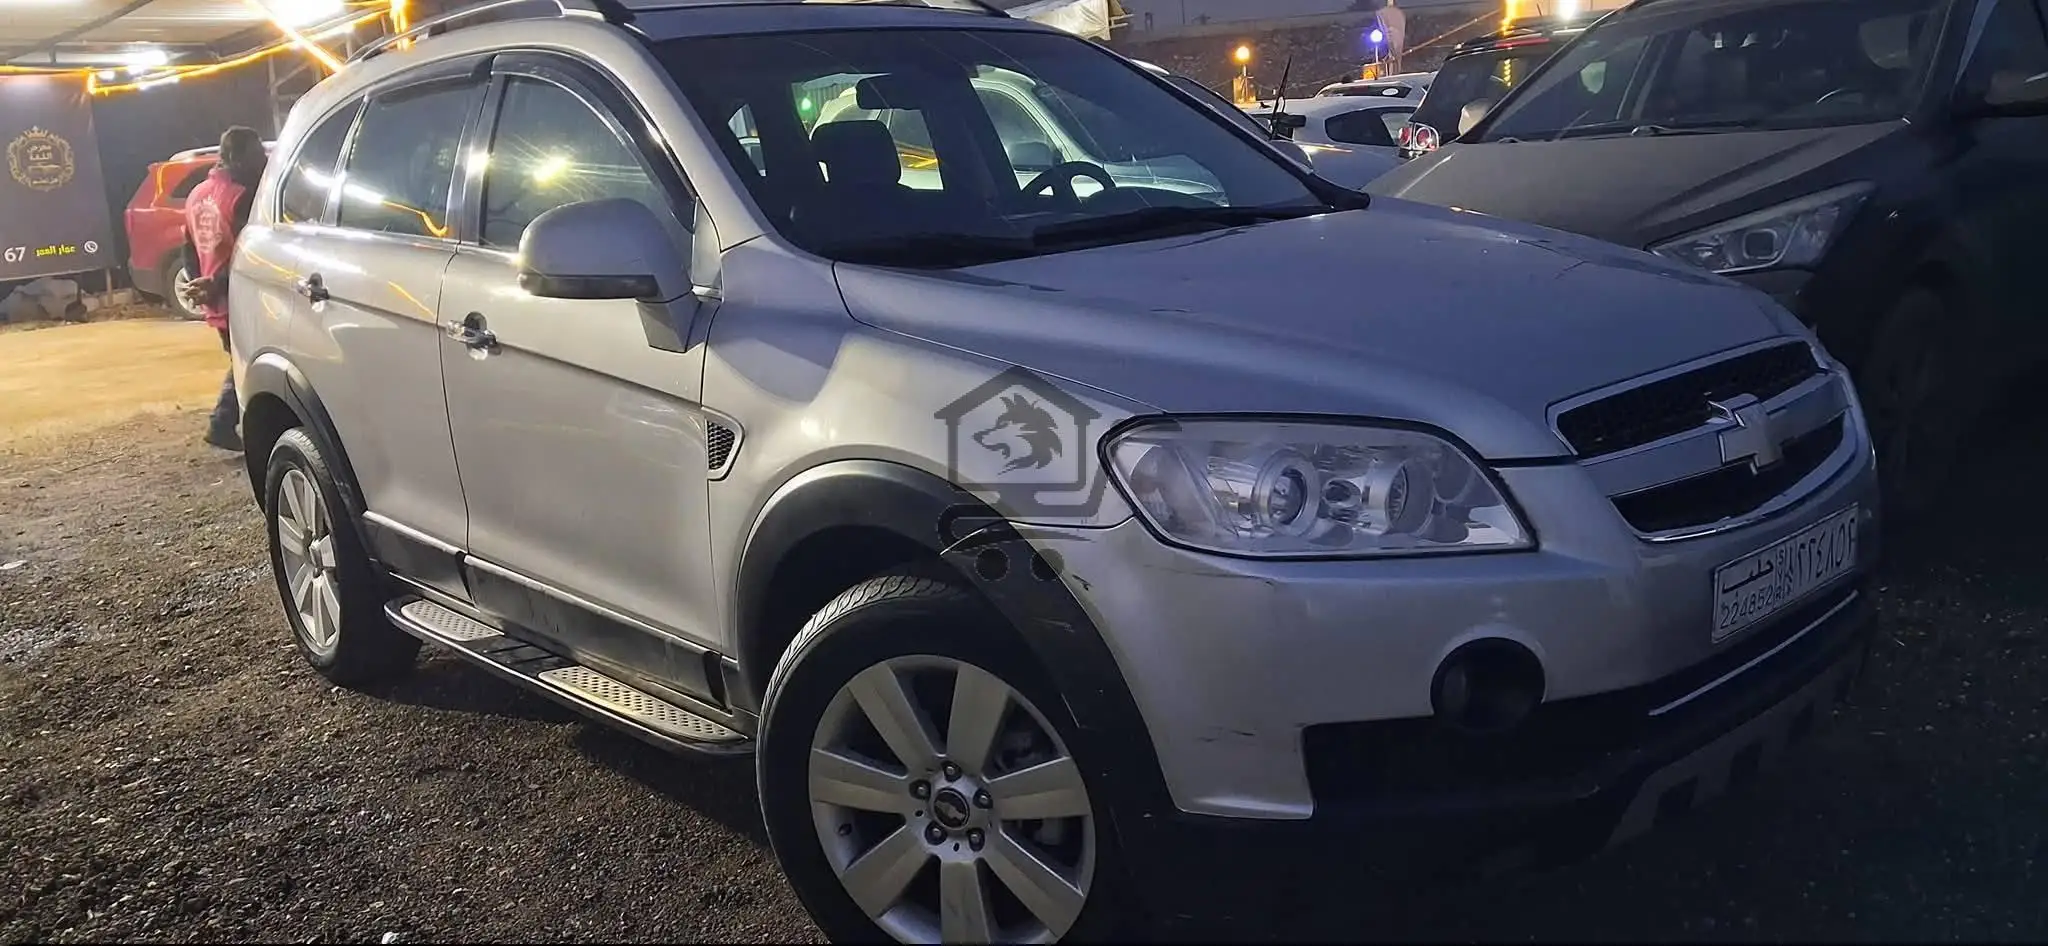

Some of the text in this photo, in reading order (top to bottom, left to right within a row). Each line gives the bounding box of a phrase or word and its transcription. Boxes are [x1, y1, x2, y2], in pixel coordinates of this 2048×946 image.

[4, 246, 26, 262] 67
[1721, 558, 1774, 598] حلب
[1719, 584, 1774, 630] 224852
